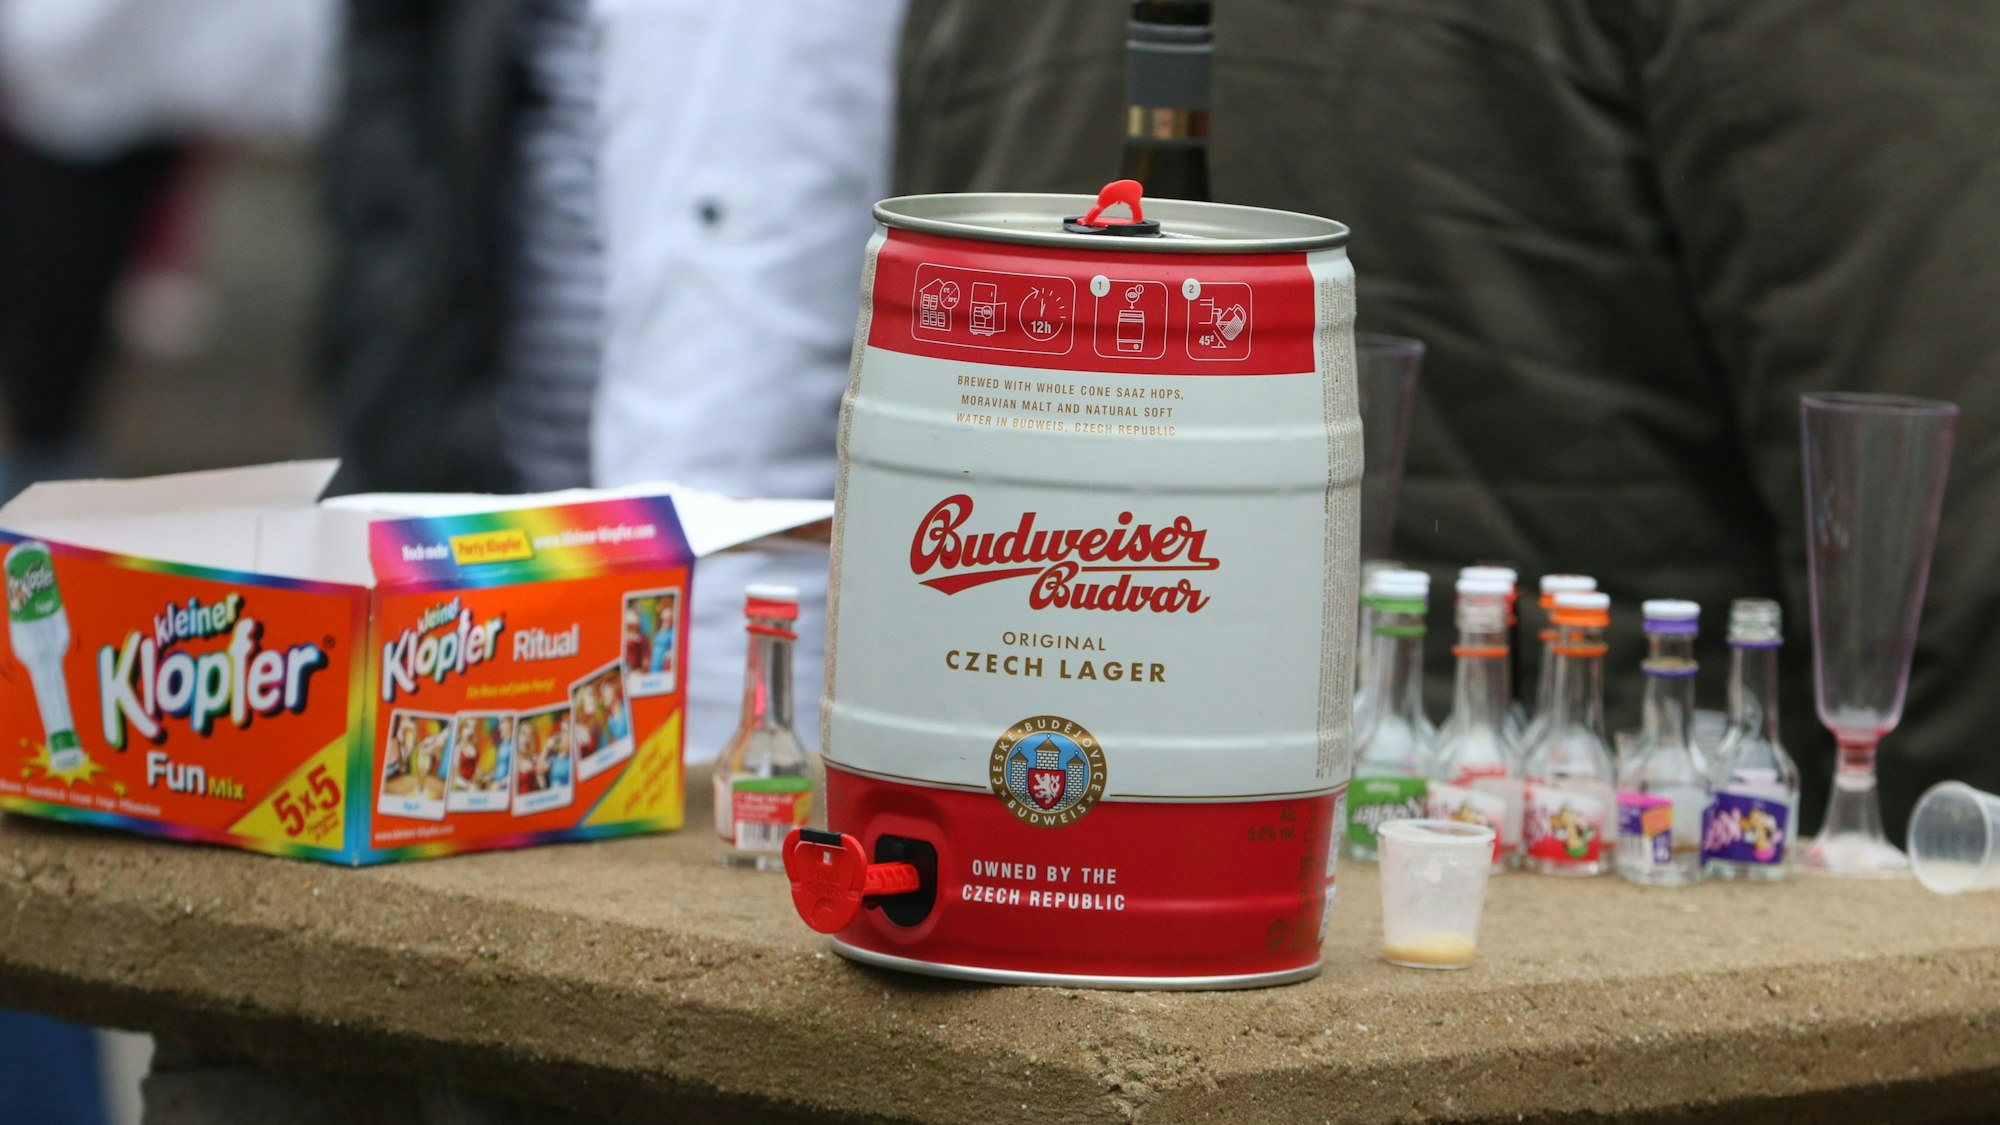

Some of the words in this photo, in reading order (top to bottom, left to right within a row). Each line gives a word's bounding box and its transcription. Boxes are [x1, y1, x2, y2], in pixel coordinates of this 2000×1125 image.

[1097, 281, 1102, 290] 1
[1188, 284, 1195, 293] 2
[1031, 320, 1051, 334] 12h
[957, 375, 999, 389] BREWED
[1004, 379, 1031, 392] WITH
[1036, 382, 1075, 395] WHOLE
[1080, 385, 1111, 397] CONE
[1116, 387, 1145, 398] SAAZ
[1151, 388, 1184, 400] HOPS,
[961, 394, 1017, 409] MORAVIAN
[1022, 401, 1052, 412] MALT
[1057, 403, 1080, 414] AND
[1085, 405, 1138, 417] NATURAL
[1144, 407, 1173, 418] SOFT
[956, 413, 991, 426] WATER
[996, 417, 1008, 427] IN
[1012, 418, 1068, 432] BUDWEIS,
[1075, 422, 1112, 434] CZECH
[1118, 425, 1176, 436] REPUBLIC
[487, 538, 522, 553] Klopfer
[910, 493, 1220, 576] Budweiser
[1029, 560, 1211, 613] Budvar
[154, 593, 242, 648] kleiner
[417, 595, 461, 635] kleiner
[1002, 631, 1106, 651] ORIGINAL
[381, 608, 505, 704] Klopfer
[513, 623, 580, 662] Ritual
[946, 649, 1043, 677] CZECH
[1059, 659, 1167, 683] LAGER
[99, 618, 327, 750] Klopfer
[992, 730, 1016, 785] ČESKÉ
[1025, 719, 1104, 791] BUDĚJOVICE
[147, 751, 206, 794] Fun
[209, 777, 244, 800] Mix
[273, 764, 341, 837] 5x5
[1008, 800, 1087, 826] BUDWEIS
[972, 859, 1037, 881] OWNED
[1047, 866, 1071, 882] BY
[1081, 868, 1117, 884] THE
[962, 884, 1021, 905] CZECH
[1029, 890, 1126, 911] REPUBLIC
